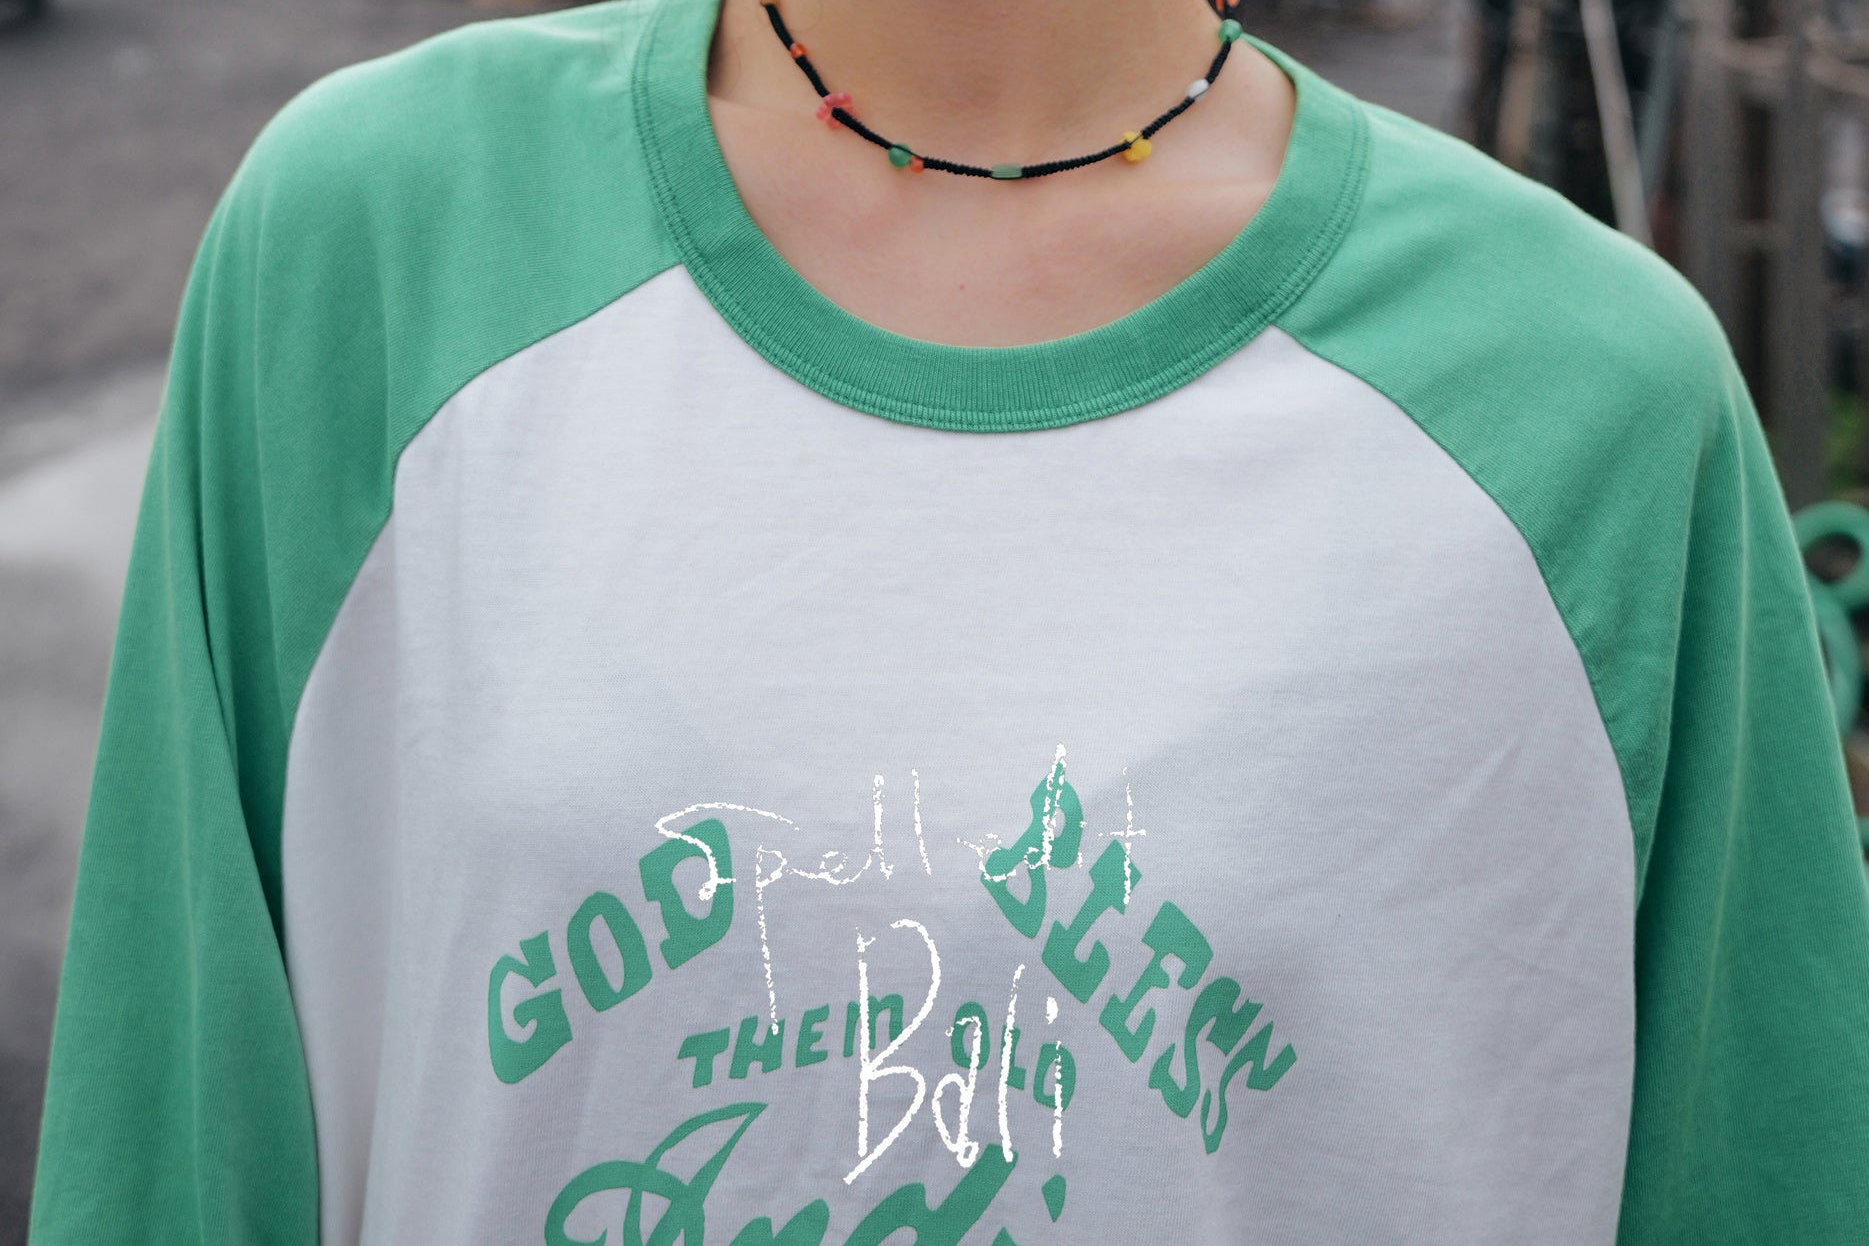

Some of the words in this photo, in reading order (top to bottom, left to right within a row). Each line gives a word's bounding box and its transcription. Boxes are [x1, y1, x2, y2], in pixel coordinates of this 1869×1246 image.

[487, 817, 734, 1084] GOD
[980, 760, 1298, 1154] BLESS
[678, 994, 904, 1089] THEM
[950, 1001, 1077, 1111] OLD
